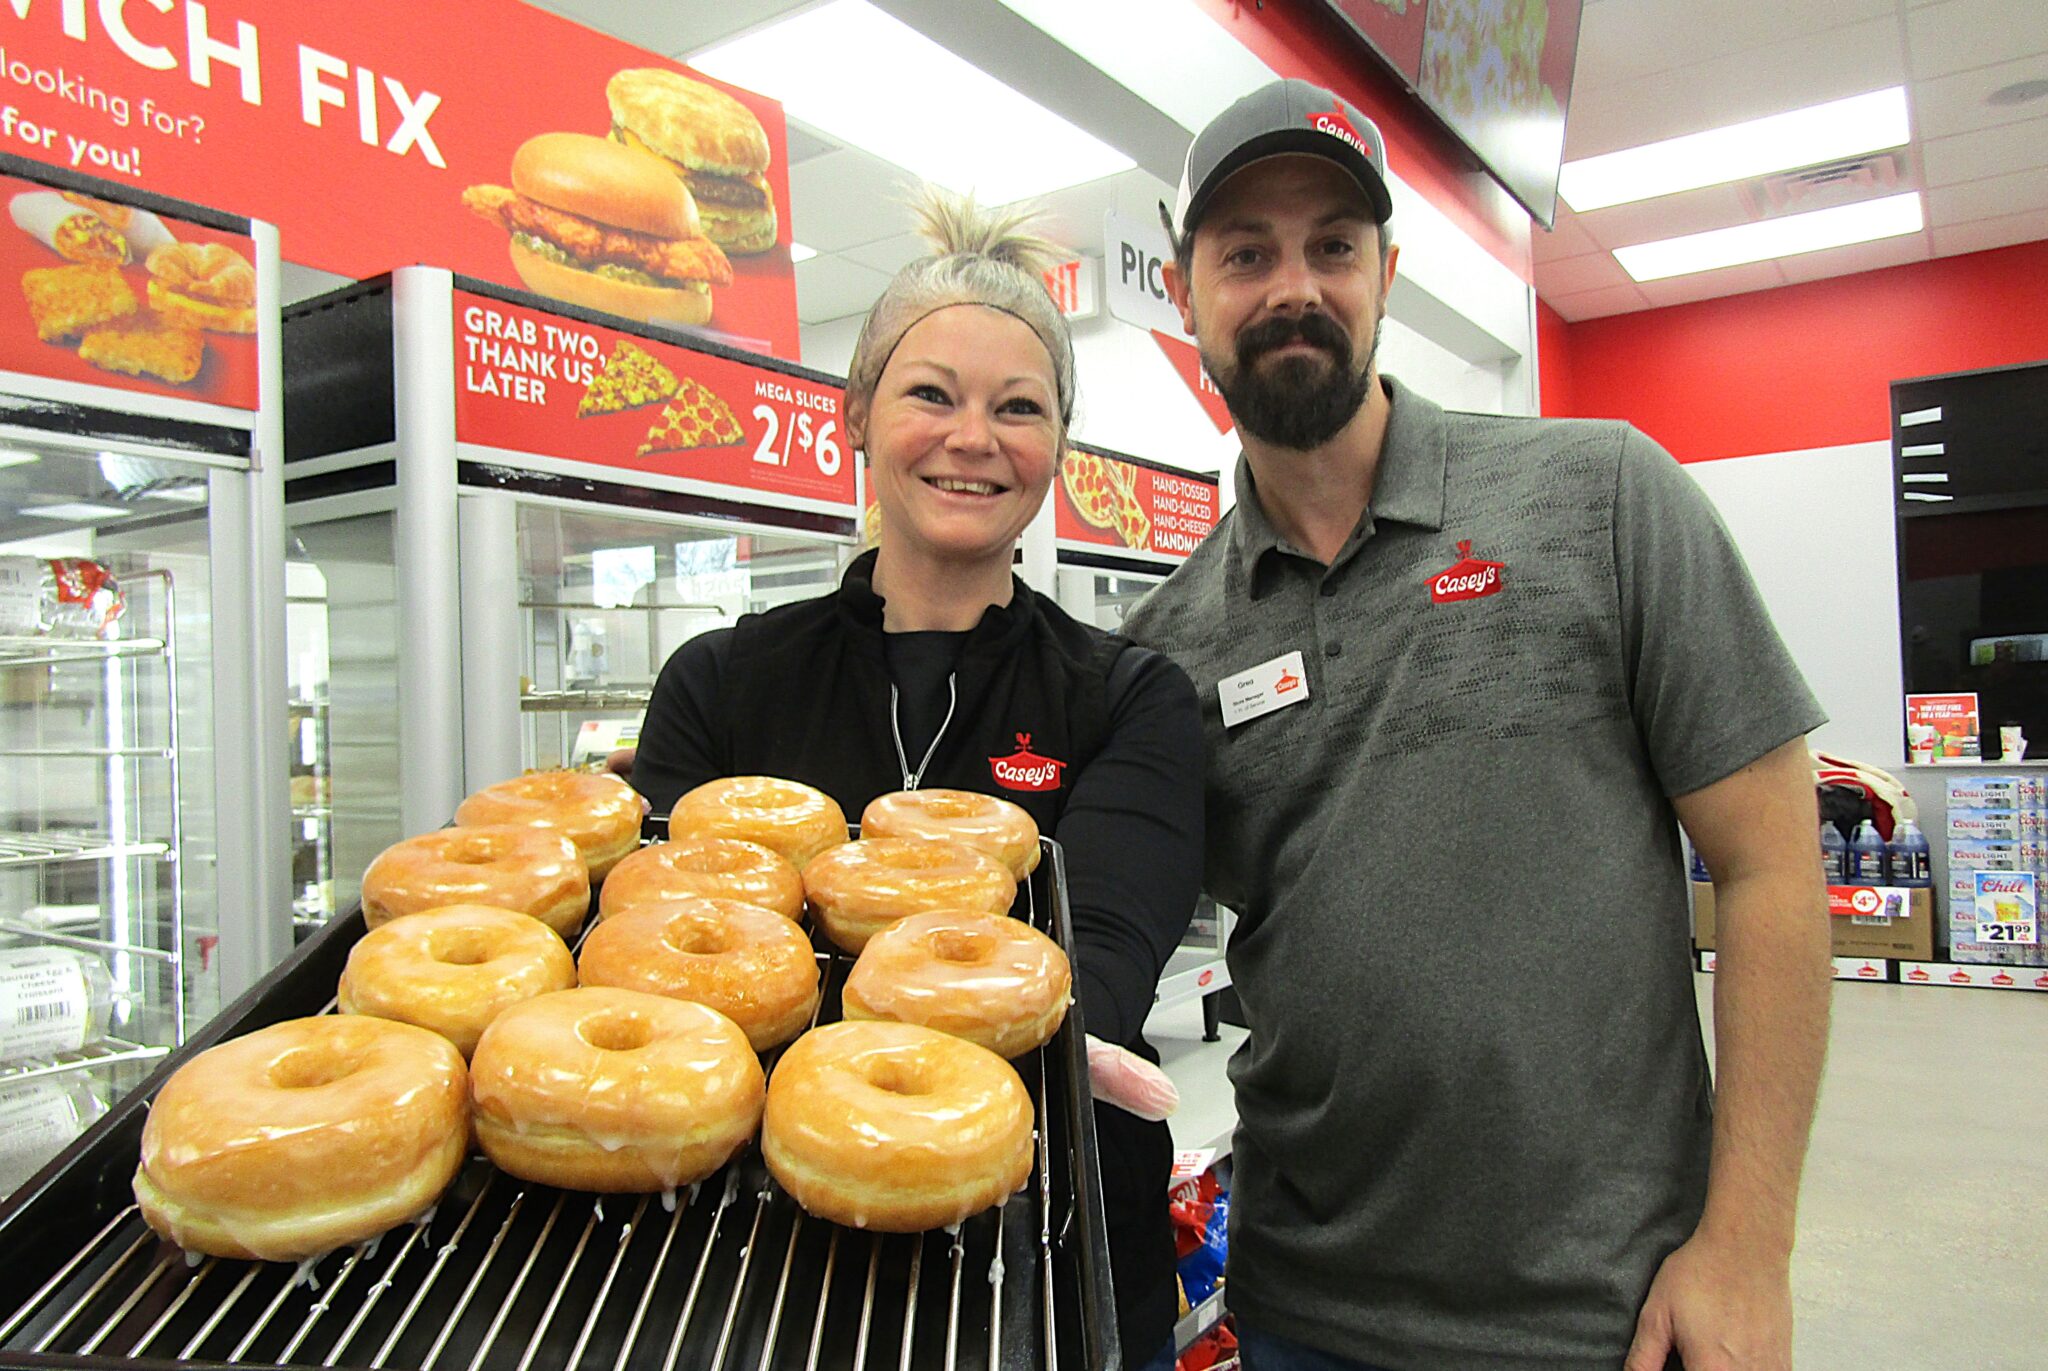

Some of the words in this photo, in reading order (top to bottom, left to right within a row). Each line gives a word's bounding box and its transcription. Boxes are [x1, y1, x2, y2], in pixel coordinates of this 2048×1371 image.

[0, 47, 130, 126] looking
[140, 99, 206, 144] for?
[8, 0, 262, 106] ICH
[298, 44, 447, 169] FIX
[0, 105, 58, 149] for
[67, 134, 141, 177] you!
[1041, 261, 1081, 315] XIT
[1121, 241, 1173, 304] PIC
[464, 306, 537, 346] GRAB
[543, 324, 607, 368] TWO,
[464, 335, 557, 380] THANK
[466, 366, 546, 405] LATER
[755, 381, 794, 404] MEGA
[795, 390, 837, 415] SLICES
[752, 404, 841, 476] 2/$6
[1152, 475, 1211, 503] HAND-TOSSED
[1153, 495, 1211, 520] HAND-SAUCED
[1154, 513, 1211, 536] HAND-CHEESED
[1154, 529, 1204, 553] HANDMA
[1435, 566, 1496, 595] Casey's
[995, 761, 1056, 786] Casey's
[1981, 880, 2025, 893] Chill
